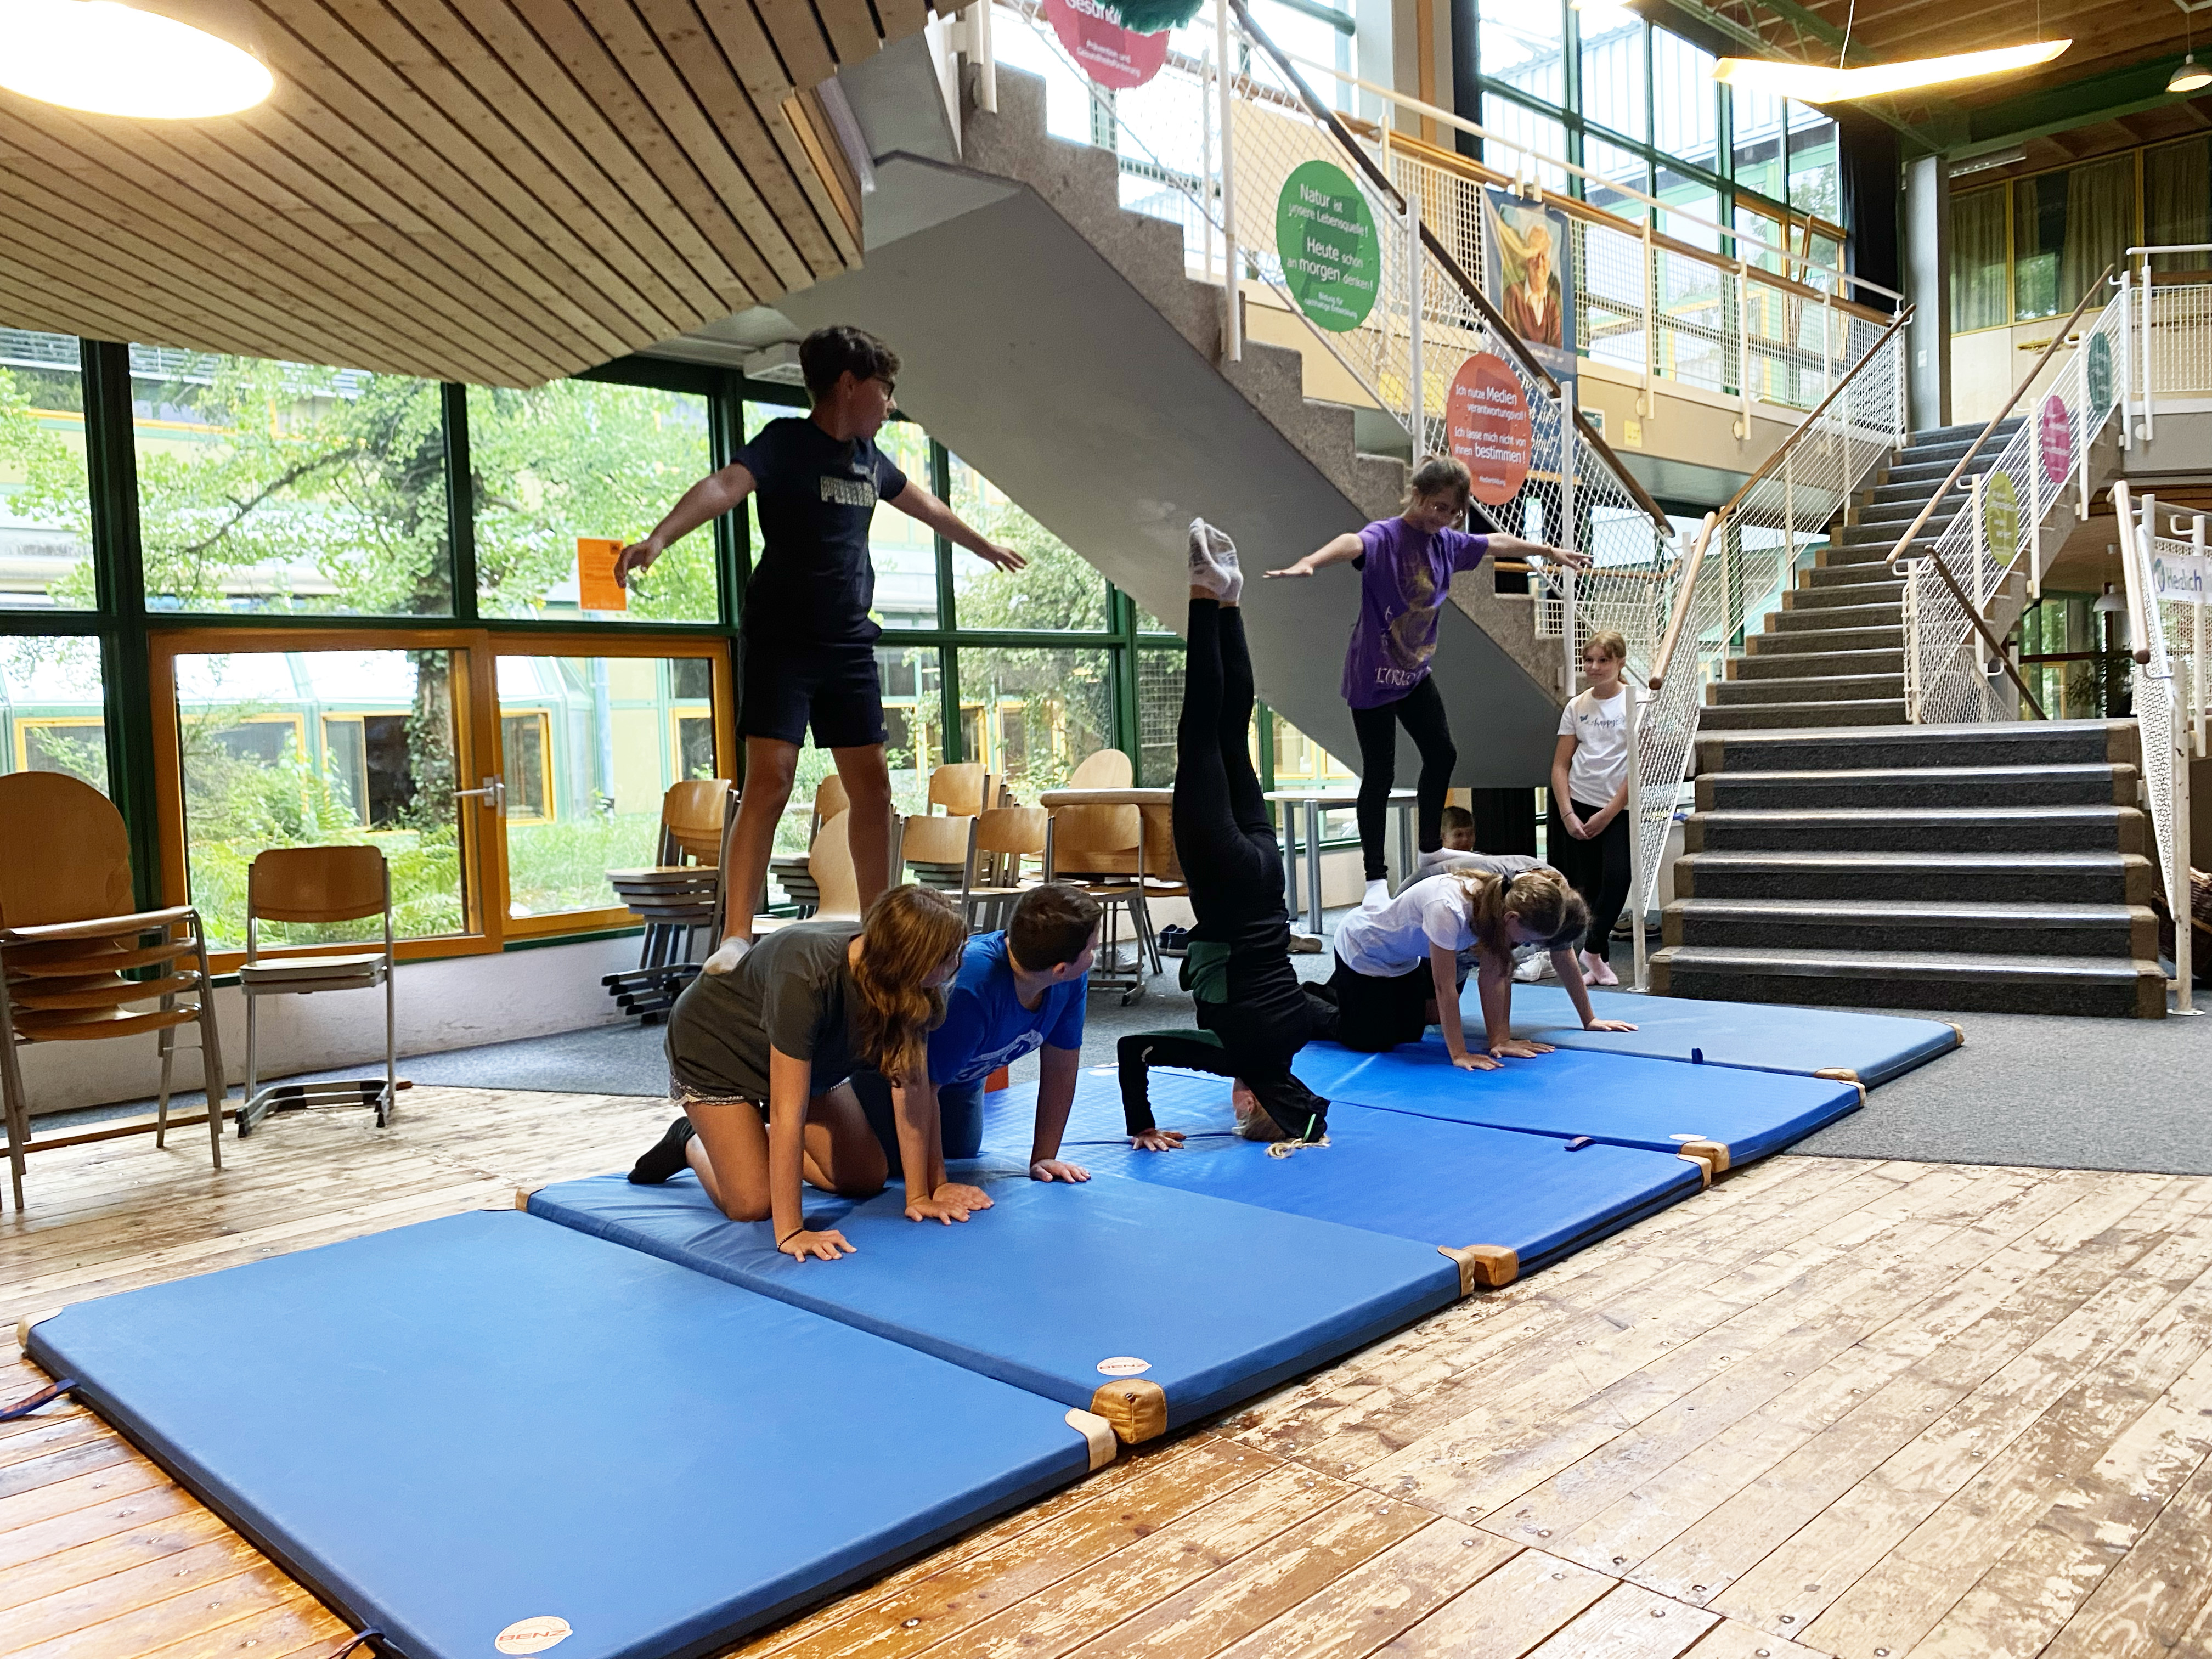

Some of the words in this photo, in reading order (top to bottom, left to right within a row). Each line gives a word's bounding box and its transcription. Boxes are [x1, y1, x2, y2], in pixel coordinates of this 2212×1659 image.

[1300, 183, 1331, 207] Natur
[1333, 199, 1343, 213] ist
[1317, 210, 1368, 238] Lebensquelle!
[1307, 236, 1339, 261] Heute
[1341, 253, 1363, 268] schon
[1287, 257, 1297, 269] an
[1299, 258, 1340, 281] morgen
[1342, 274, 1373, 291] denken!
[1455, 384, 1466, 396] Ich
[1468, 388, 1485, 399] nutze
[1486, 386, 1517, 406] Medien
[1467, 403, 1526, 421] verantwortungsvoll!
[1454, 426, 1465, 437] Ich
[1466, 427, 1482, 441] lasse
[1483, 432, 1498, 442] mich
[1499, 434, 1514, 445] nicht
[1515, 438, 1526, 447] von
[1475, 442, 1525, 464] bestimmen!
[1594, 717, 1616, 729] happy
[499, 1630, 566, 1641] BENZ
